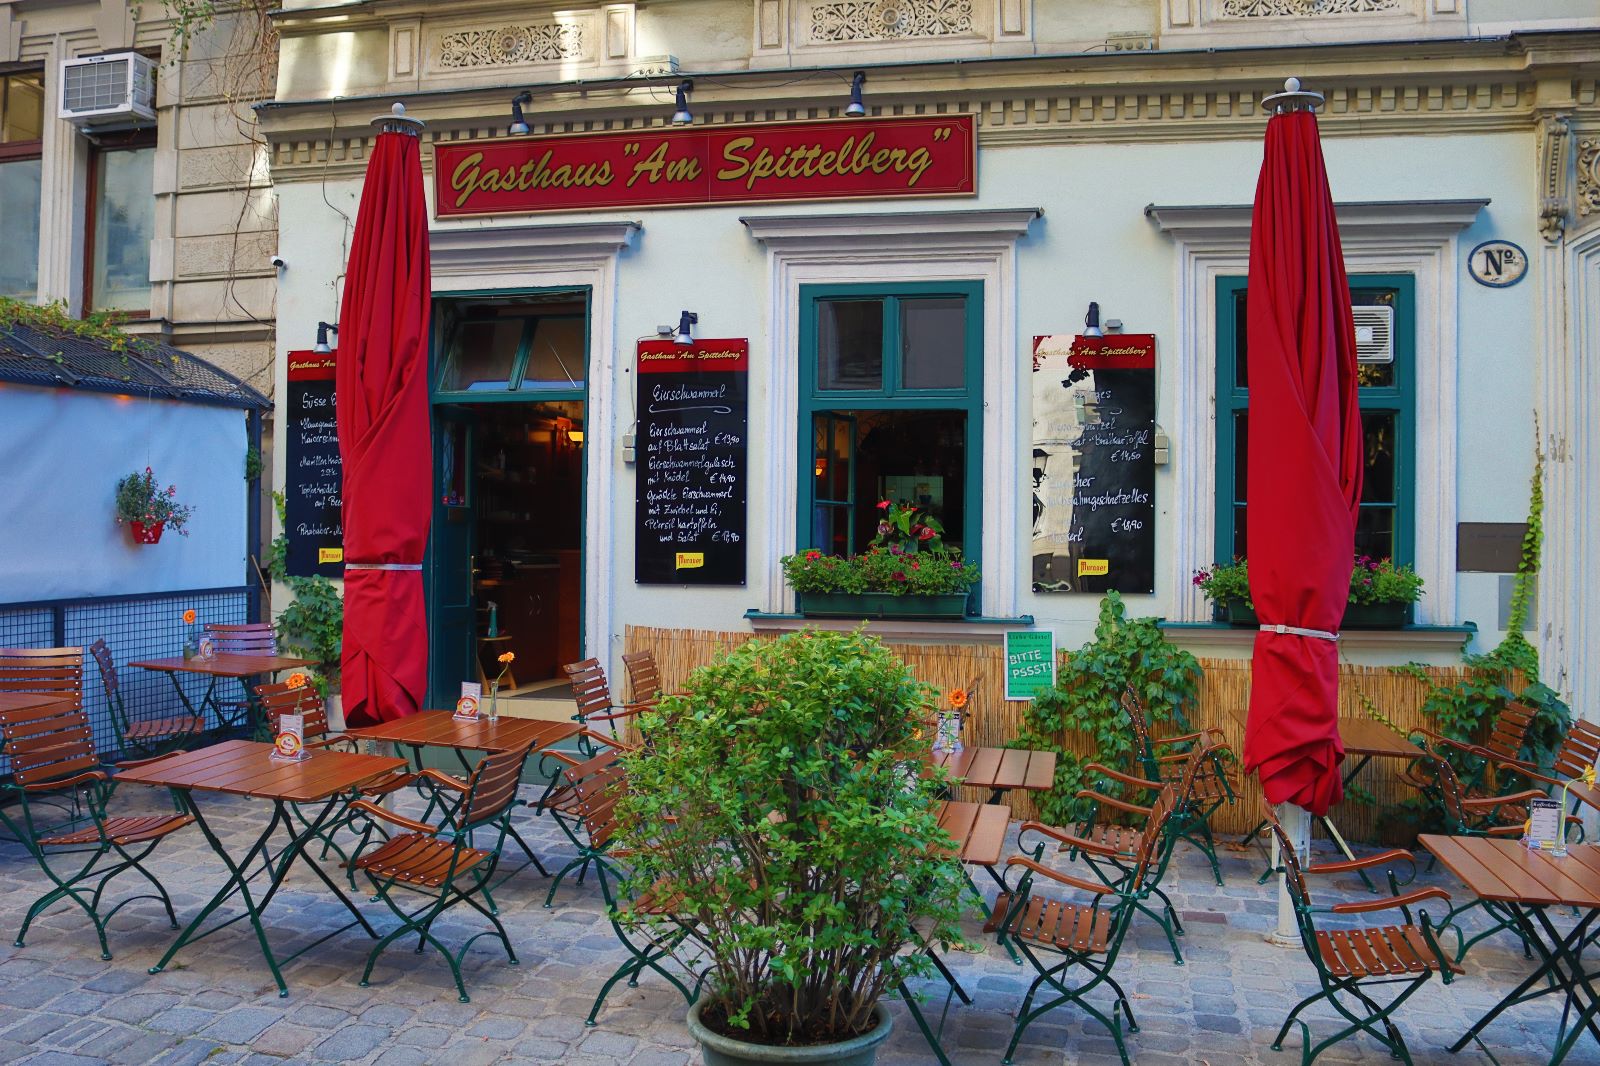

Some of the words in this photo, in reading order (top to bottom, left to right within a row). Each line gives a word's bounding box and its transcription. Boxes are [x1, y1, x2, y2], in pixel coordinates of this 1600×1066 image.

[451, 150, 615, 207] Gasthaus
[624, 141, 702, 187] "Am
[717, 127, 951, 190] Spittelberg"
[640, 352, 676, 362] Gasthaus
[290, 361, 320, 371] Gasthaus
[301, 430, 339, 444] Kaiserschm
[1009, 649, 1042, 665] BITTE
[1012, 662, 1052, 679] PSSST!
